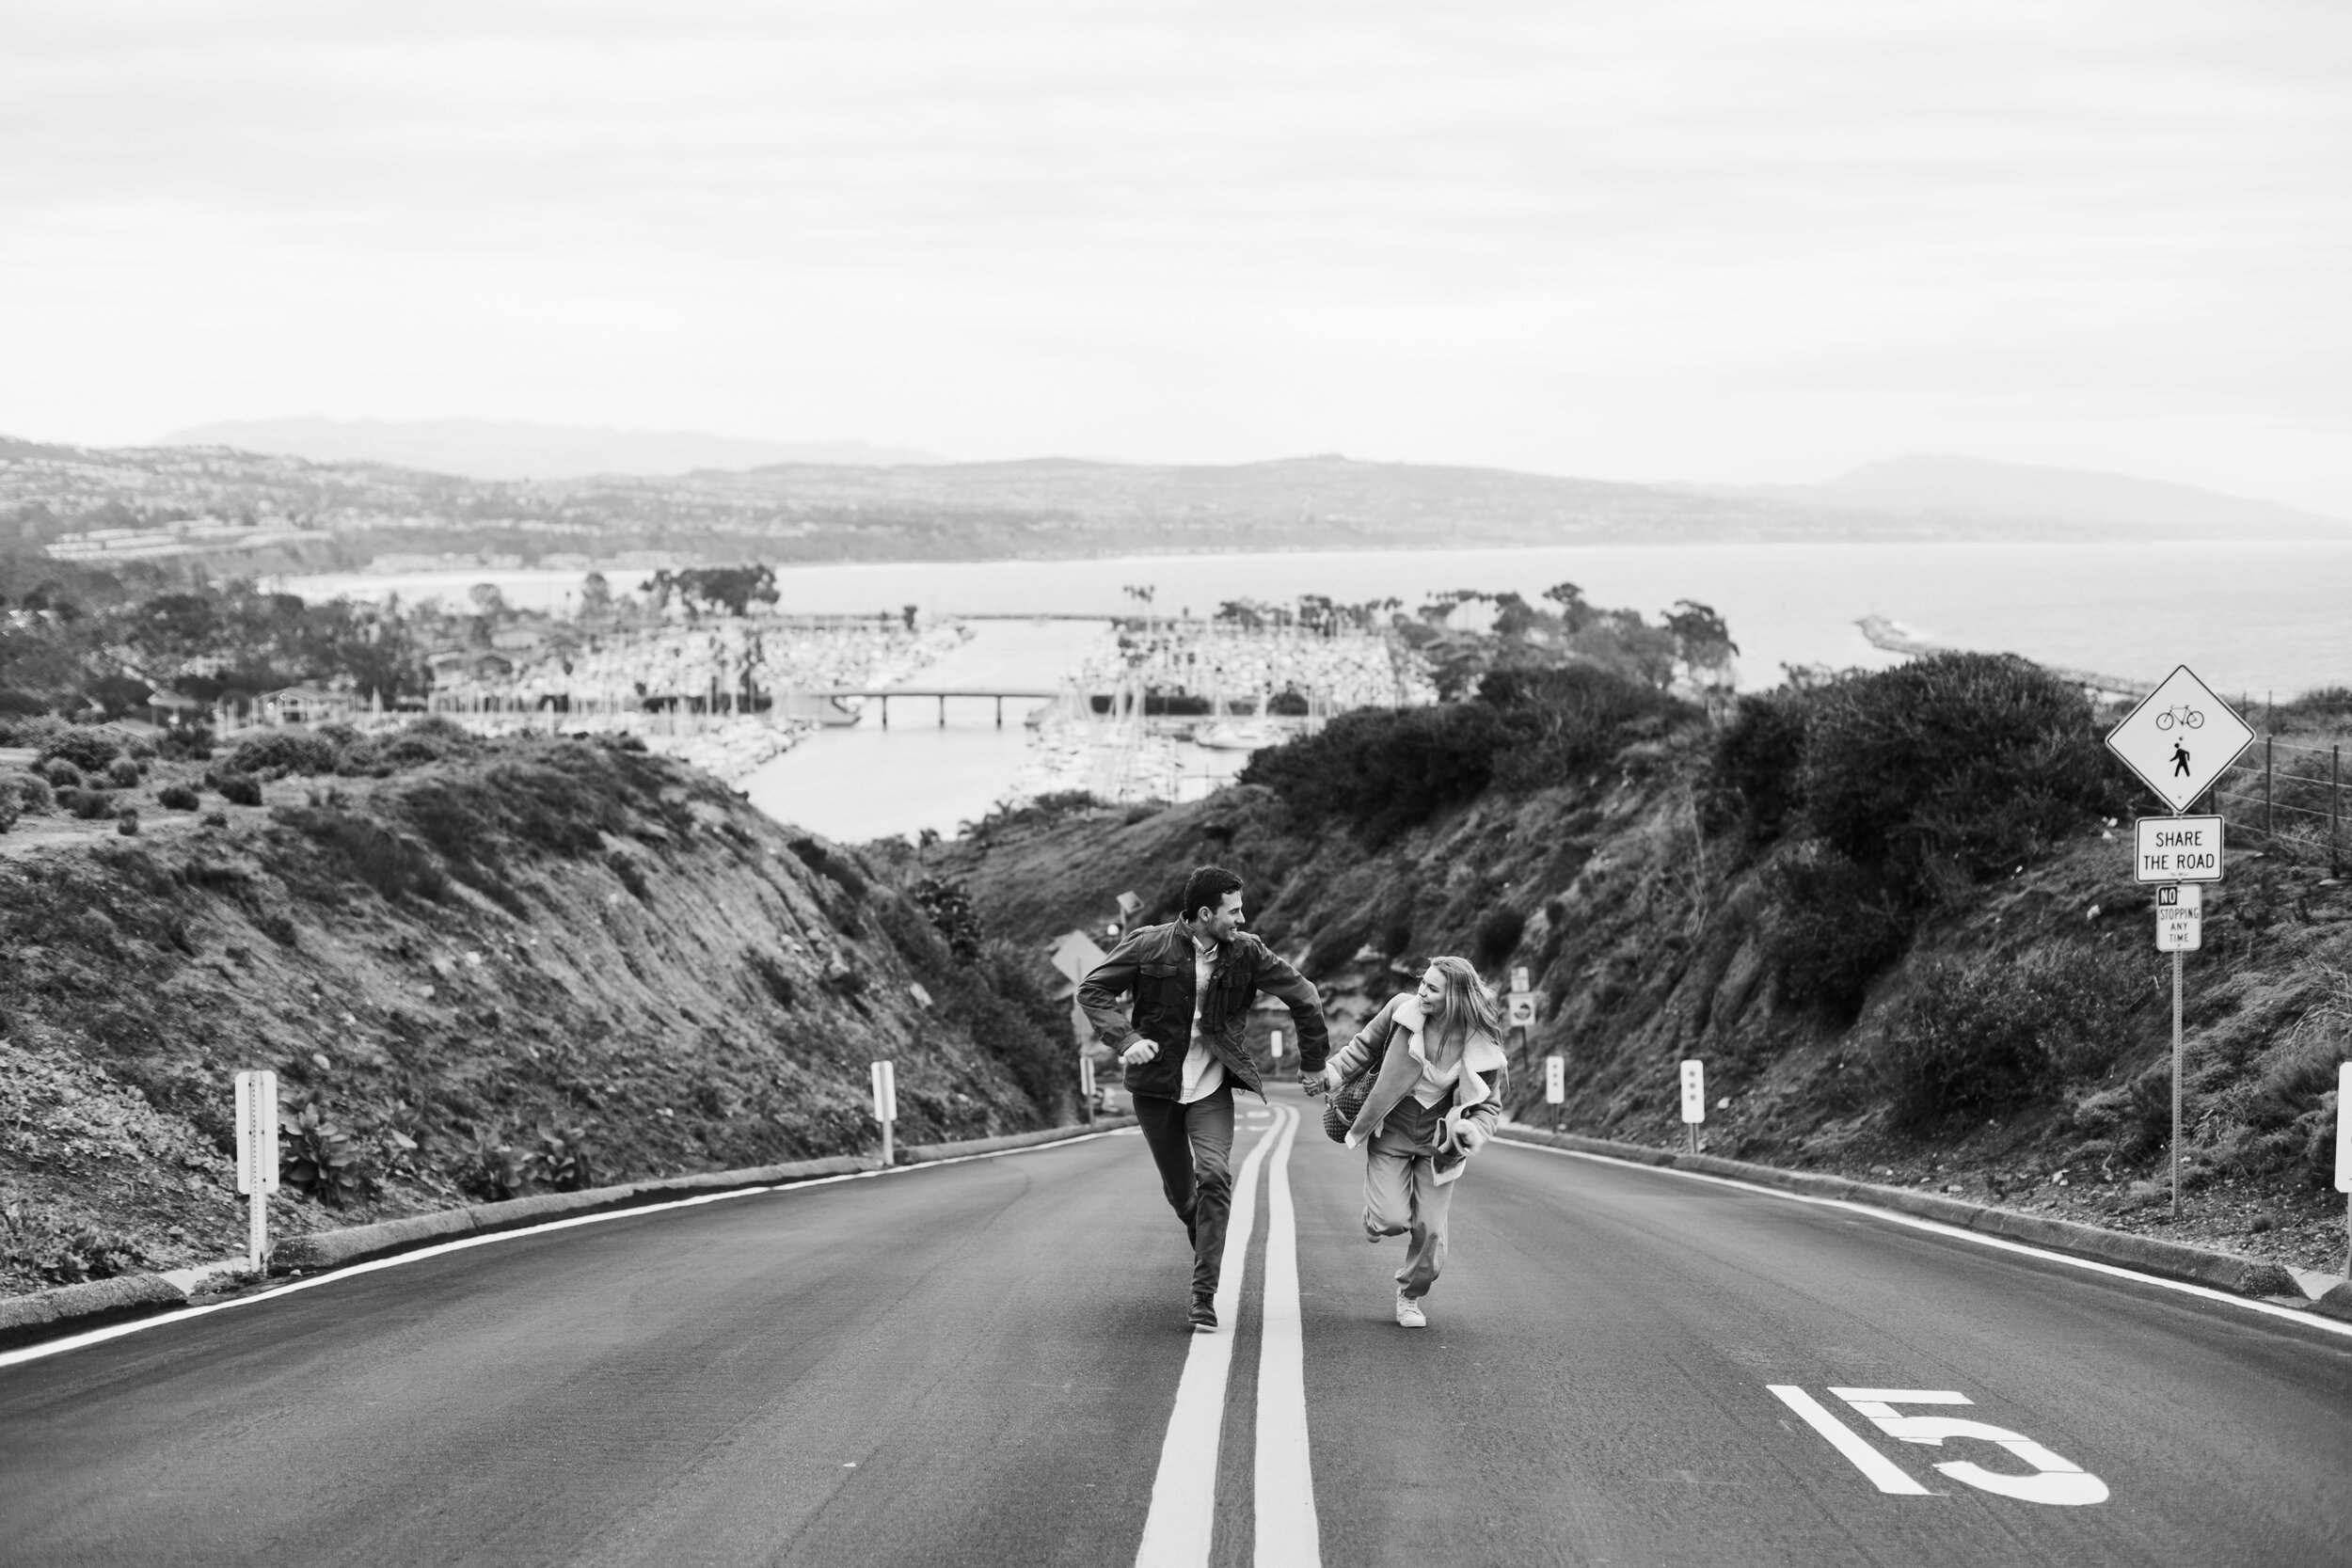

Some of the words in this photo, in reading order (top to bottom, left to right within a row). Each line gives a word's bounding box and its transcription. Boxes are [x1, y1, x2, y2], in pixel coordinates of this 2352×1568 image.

[2156, 832, 2202, 847] SHARE
[2144, 855, 2169, 870] THE
[2177, 853, 2215, 869] ROAD
[2160, 889, 2176, 904] NO
[2160, 907, 2200, 921] STOPPING
[2170, 923, 2187, 931] ANY
[2169, 933, 2189, 942] TIME
[1766, 1385, 2110, 1506] 15
